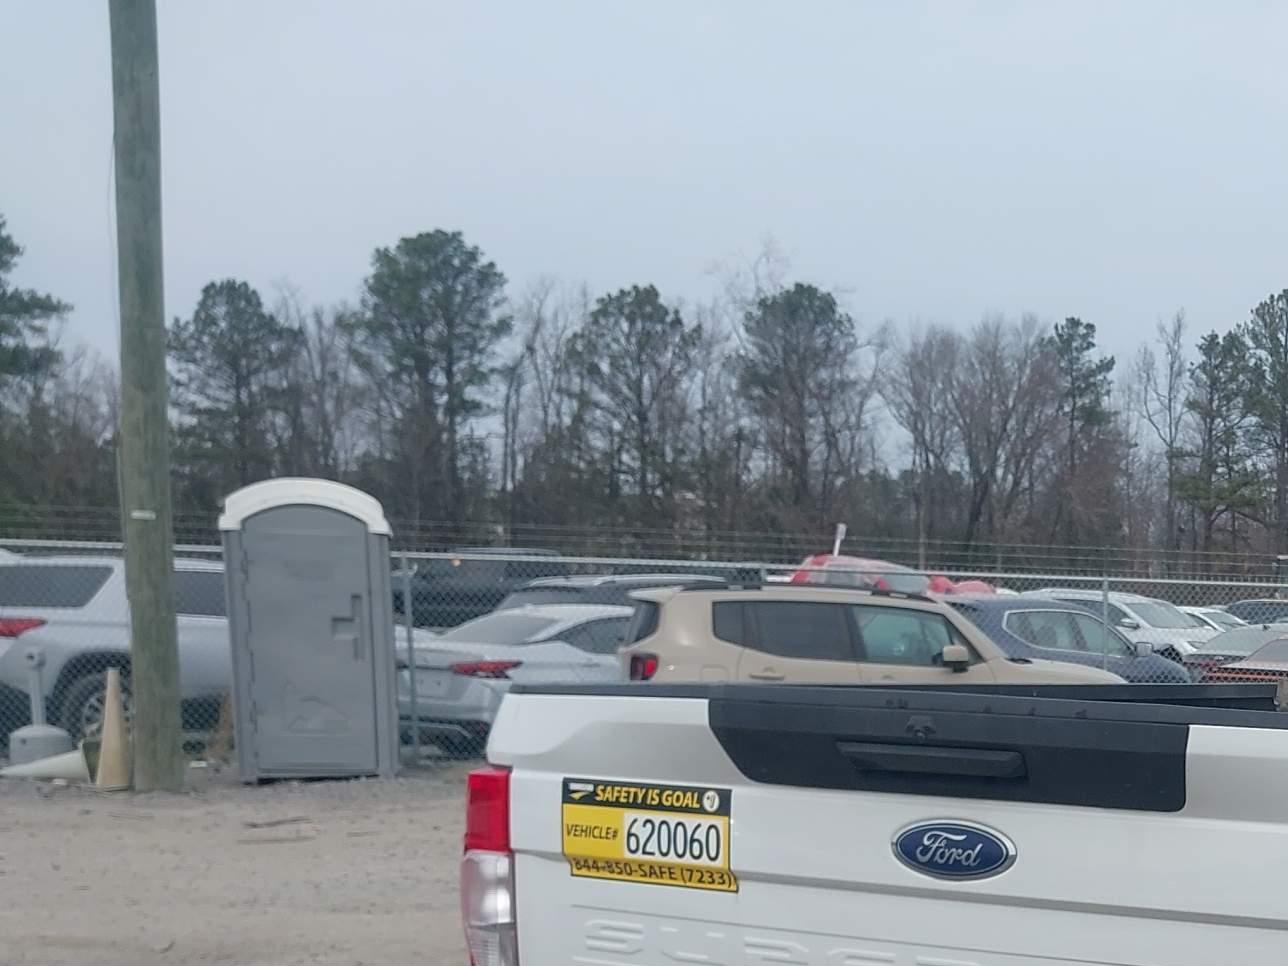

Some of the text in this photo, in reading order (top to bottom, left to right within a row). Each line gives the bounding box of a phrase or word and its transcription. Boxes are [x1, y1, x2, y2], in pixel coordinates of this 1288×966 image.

[595, 785, 646, 804] SAFETY
[646, 790, 661, 806] IS
[661, 791, 701, 809] GOAL
[566, 823, 618, 841] VEHICLE#
[626, 817, 721, 862] 620060
[916, 830, 983, 867] Ford
[681, 868, 732, 889] (7233)
